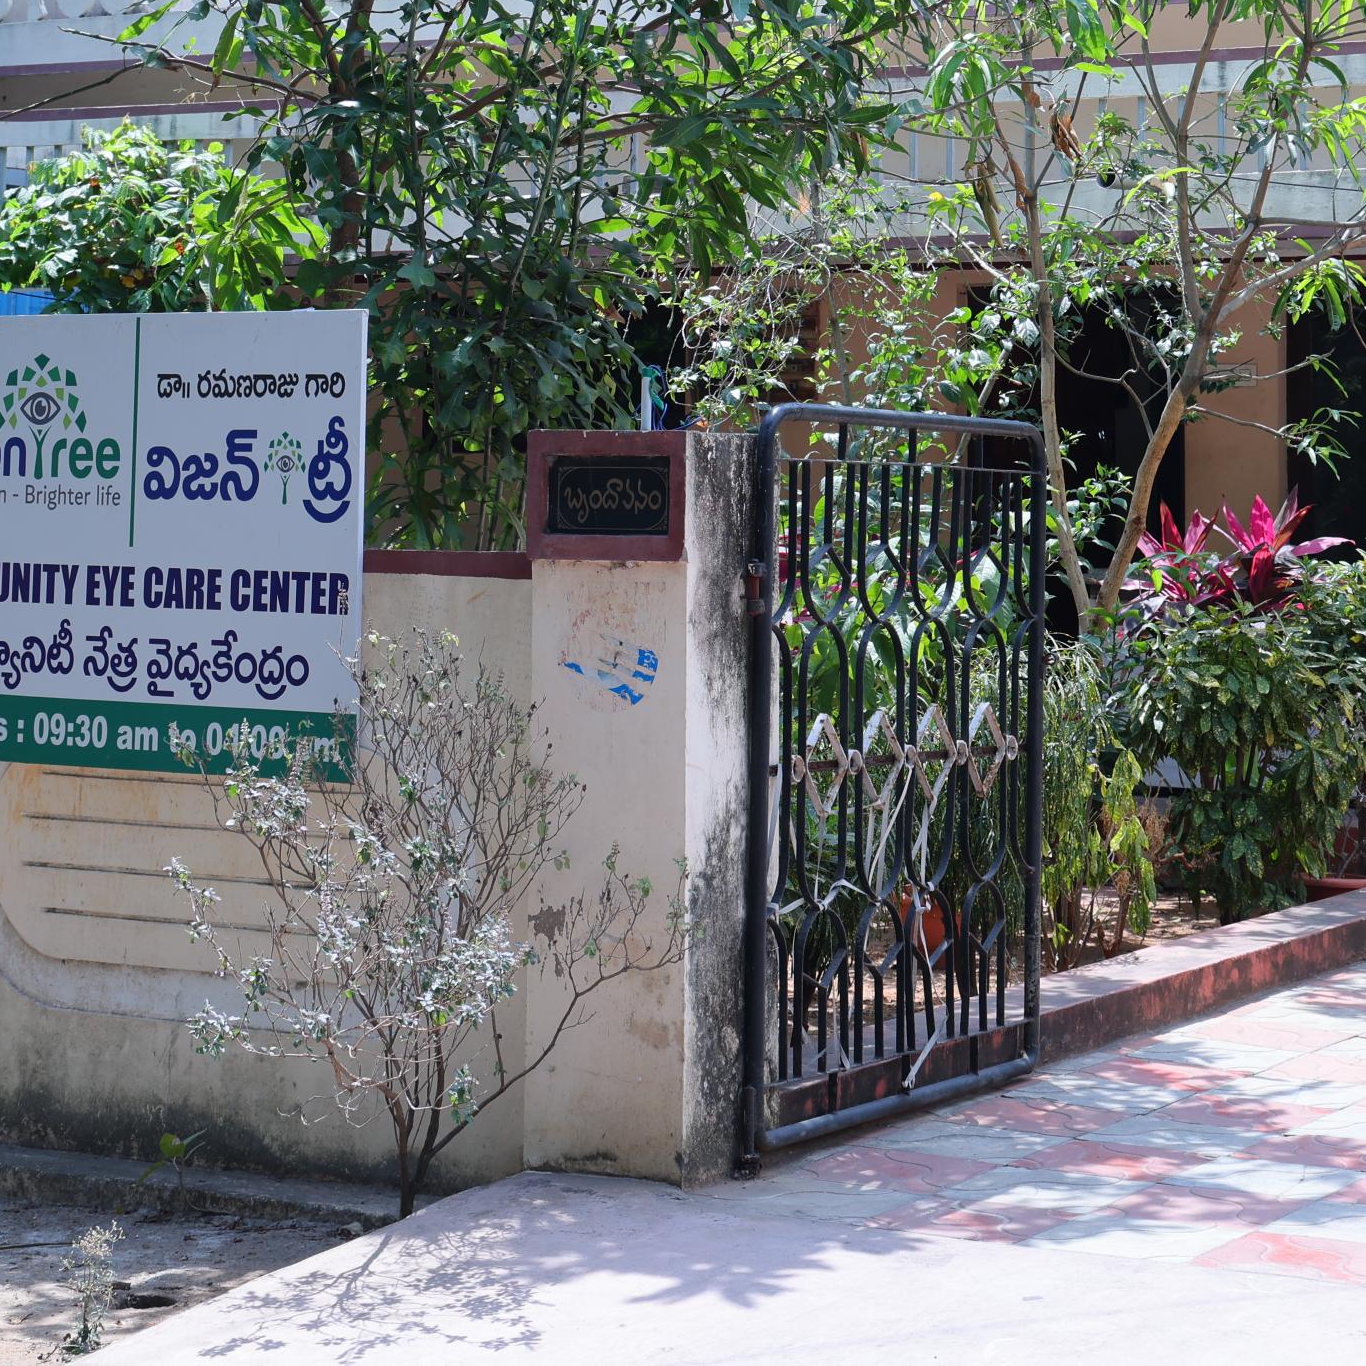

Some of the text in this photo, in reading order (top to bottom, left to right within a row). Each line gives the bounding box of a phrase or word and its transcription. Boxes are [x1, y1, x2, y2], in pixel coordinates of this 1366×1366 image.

[197, 368, 299, 399] రమణరాజు
[305, 371, 346, 399] గారి
[143, 415, 352, 524] విజన్ ట్రీ
[25, 484, 91, 510] Brighter
[96, 484, 121, 506] life
[85, 565, 136, 608] EYE
[143, 566, 223, 611] CARE
[230, 568, 350, 616] CENTER
[83, 625, 138, 693] నేత్ర
[146, 629, 310, 701] వైద్యకేంద్రం
[33, 712, 108, 749] 09:30
[116, 725, 159, 752] am
